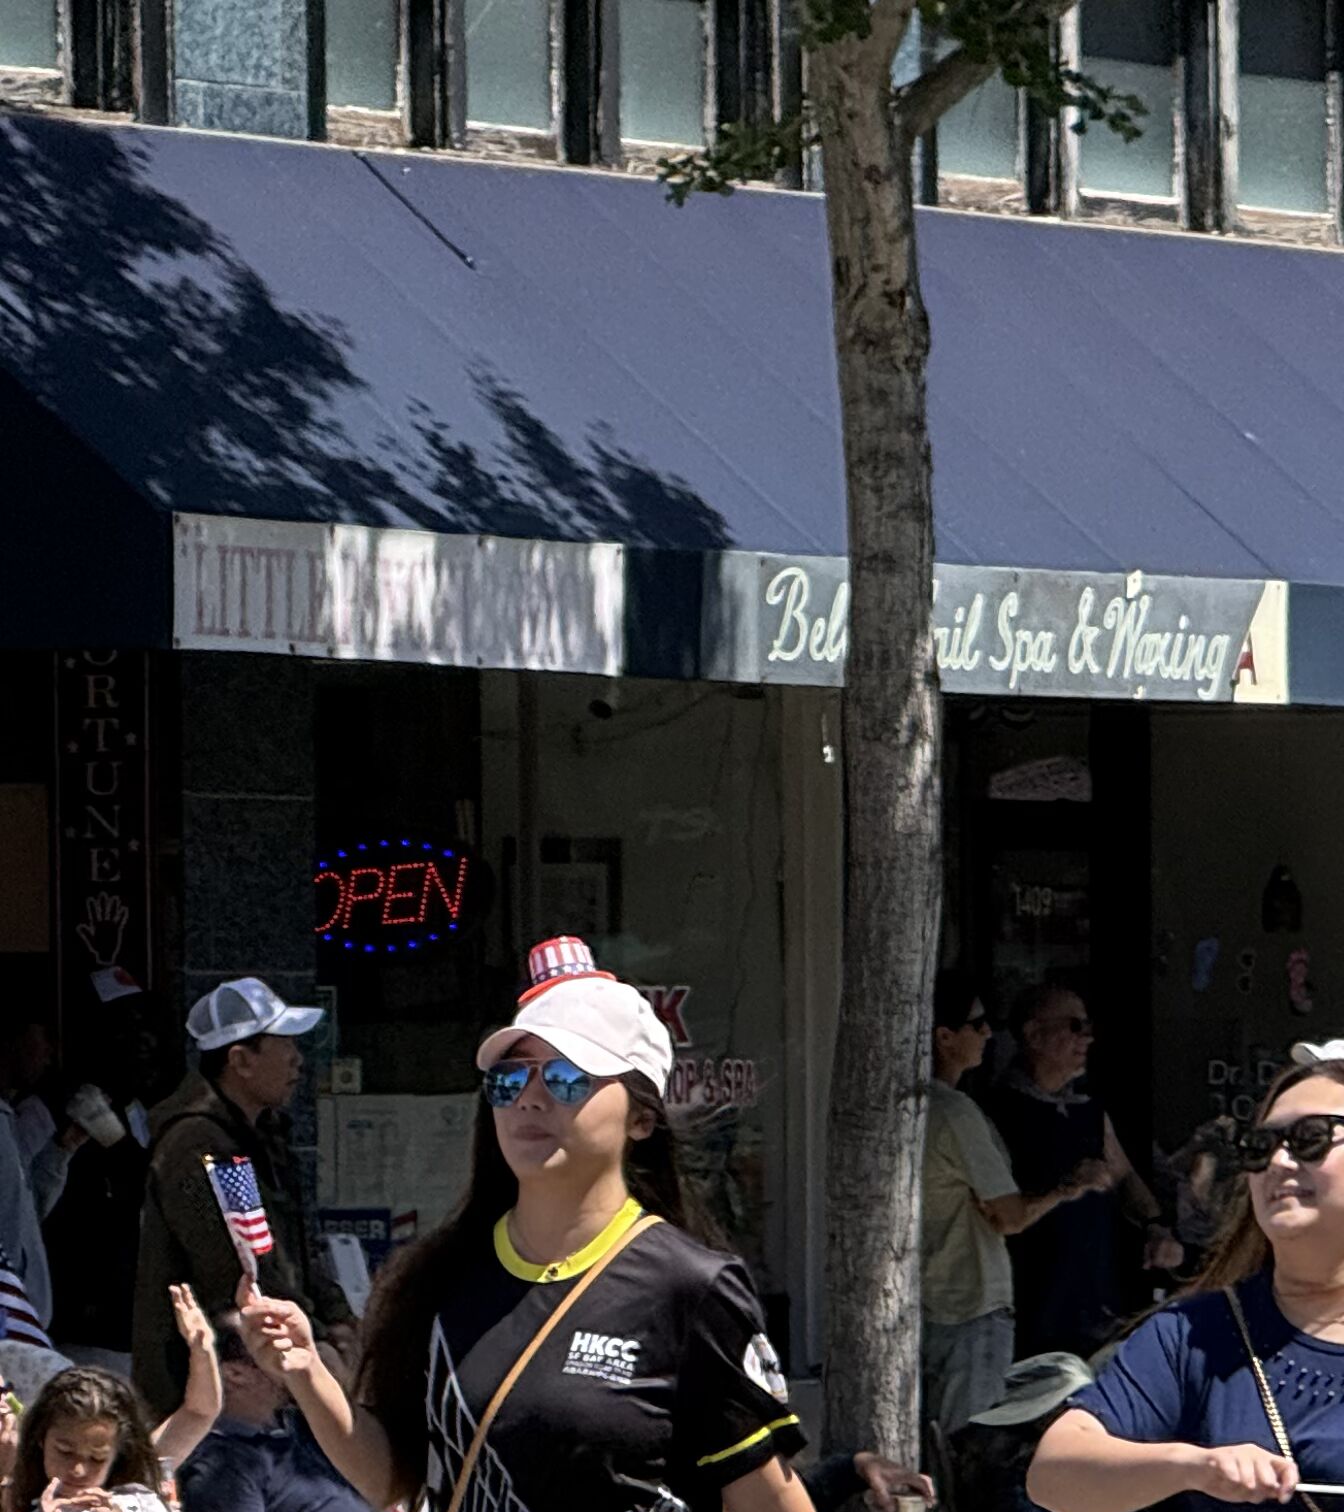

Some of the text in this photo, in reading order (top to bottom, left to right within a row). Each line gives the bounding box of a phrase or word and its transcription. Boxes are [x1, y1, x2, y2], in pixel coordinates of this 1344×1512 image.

[766, 567, 847, 662] Bel
[990, 592, 1057, 689] Spa
[1069, 587, 1105, 675] &
[1104, 595, 1231, 700] Waxing
[314, 856, 468, 934] OPEN
[570, 1331, 641, 1362] HKCC
